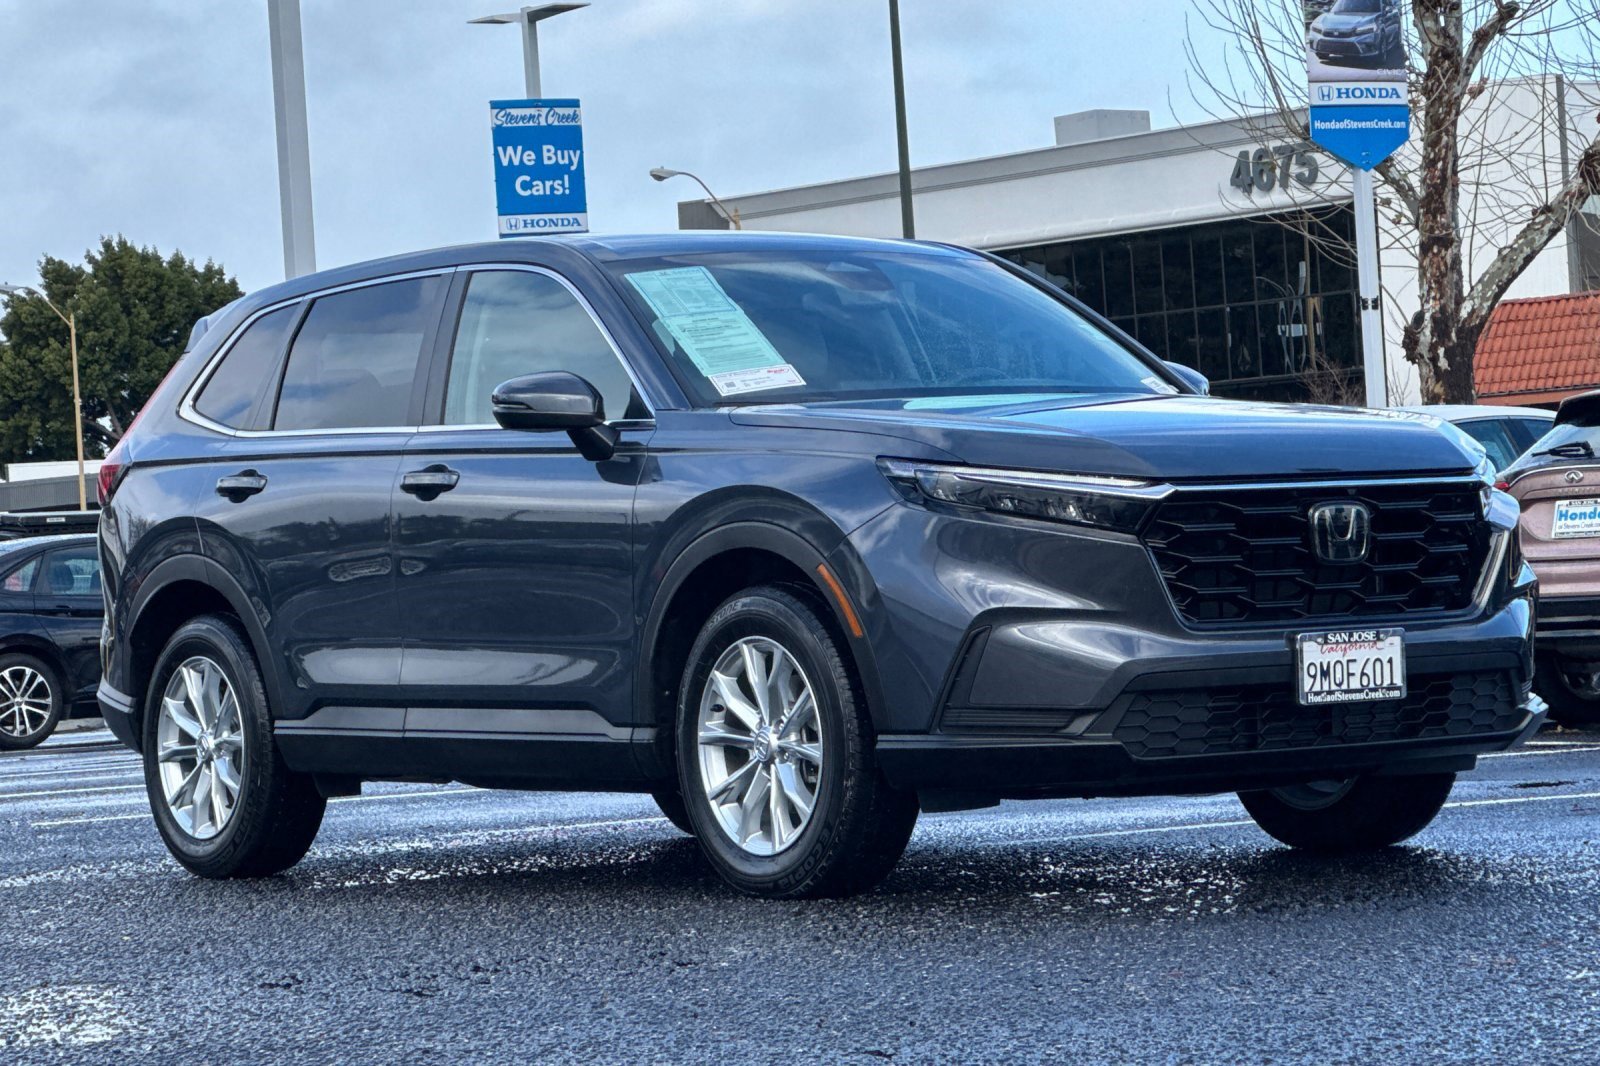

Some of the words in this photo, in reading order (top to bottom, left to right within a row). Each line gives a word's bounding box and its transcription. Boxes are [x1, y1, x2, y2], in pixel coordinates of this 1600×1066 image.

[1336, 87, 1401, 99] HONDA
[495, 108, 542, 127] Stevens
[545, 107, 580, 126] Creek
[1314, 119, 1406, 130] HondaofStevensCreek.com
[497, 145, 536, 167] We
[542, 144, 581, 171] Buy
[1230, 142, 1319, 194] 4675
[515, 174, 570, 197] Cars!
[522, 217, 582, 229] HONDA
[1327, 632, 1349, 643] SAN
[1350, 631, 1377, 642] JOSE
[1306, 656, 1398, 691] 9MQF601
